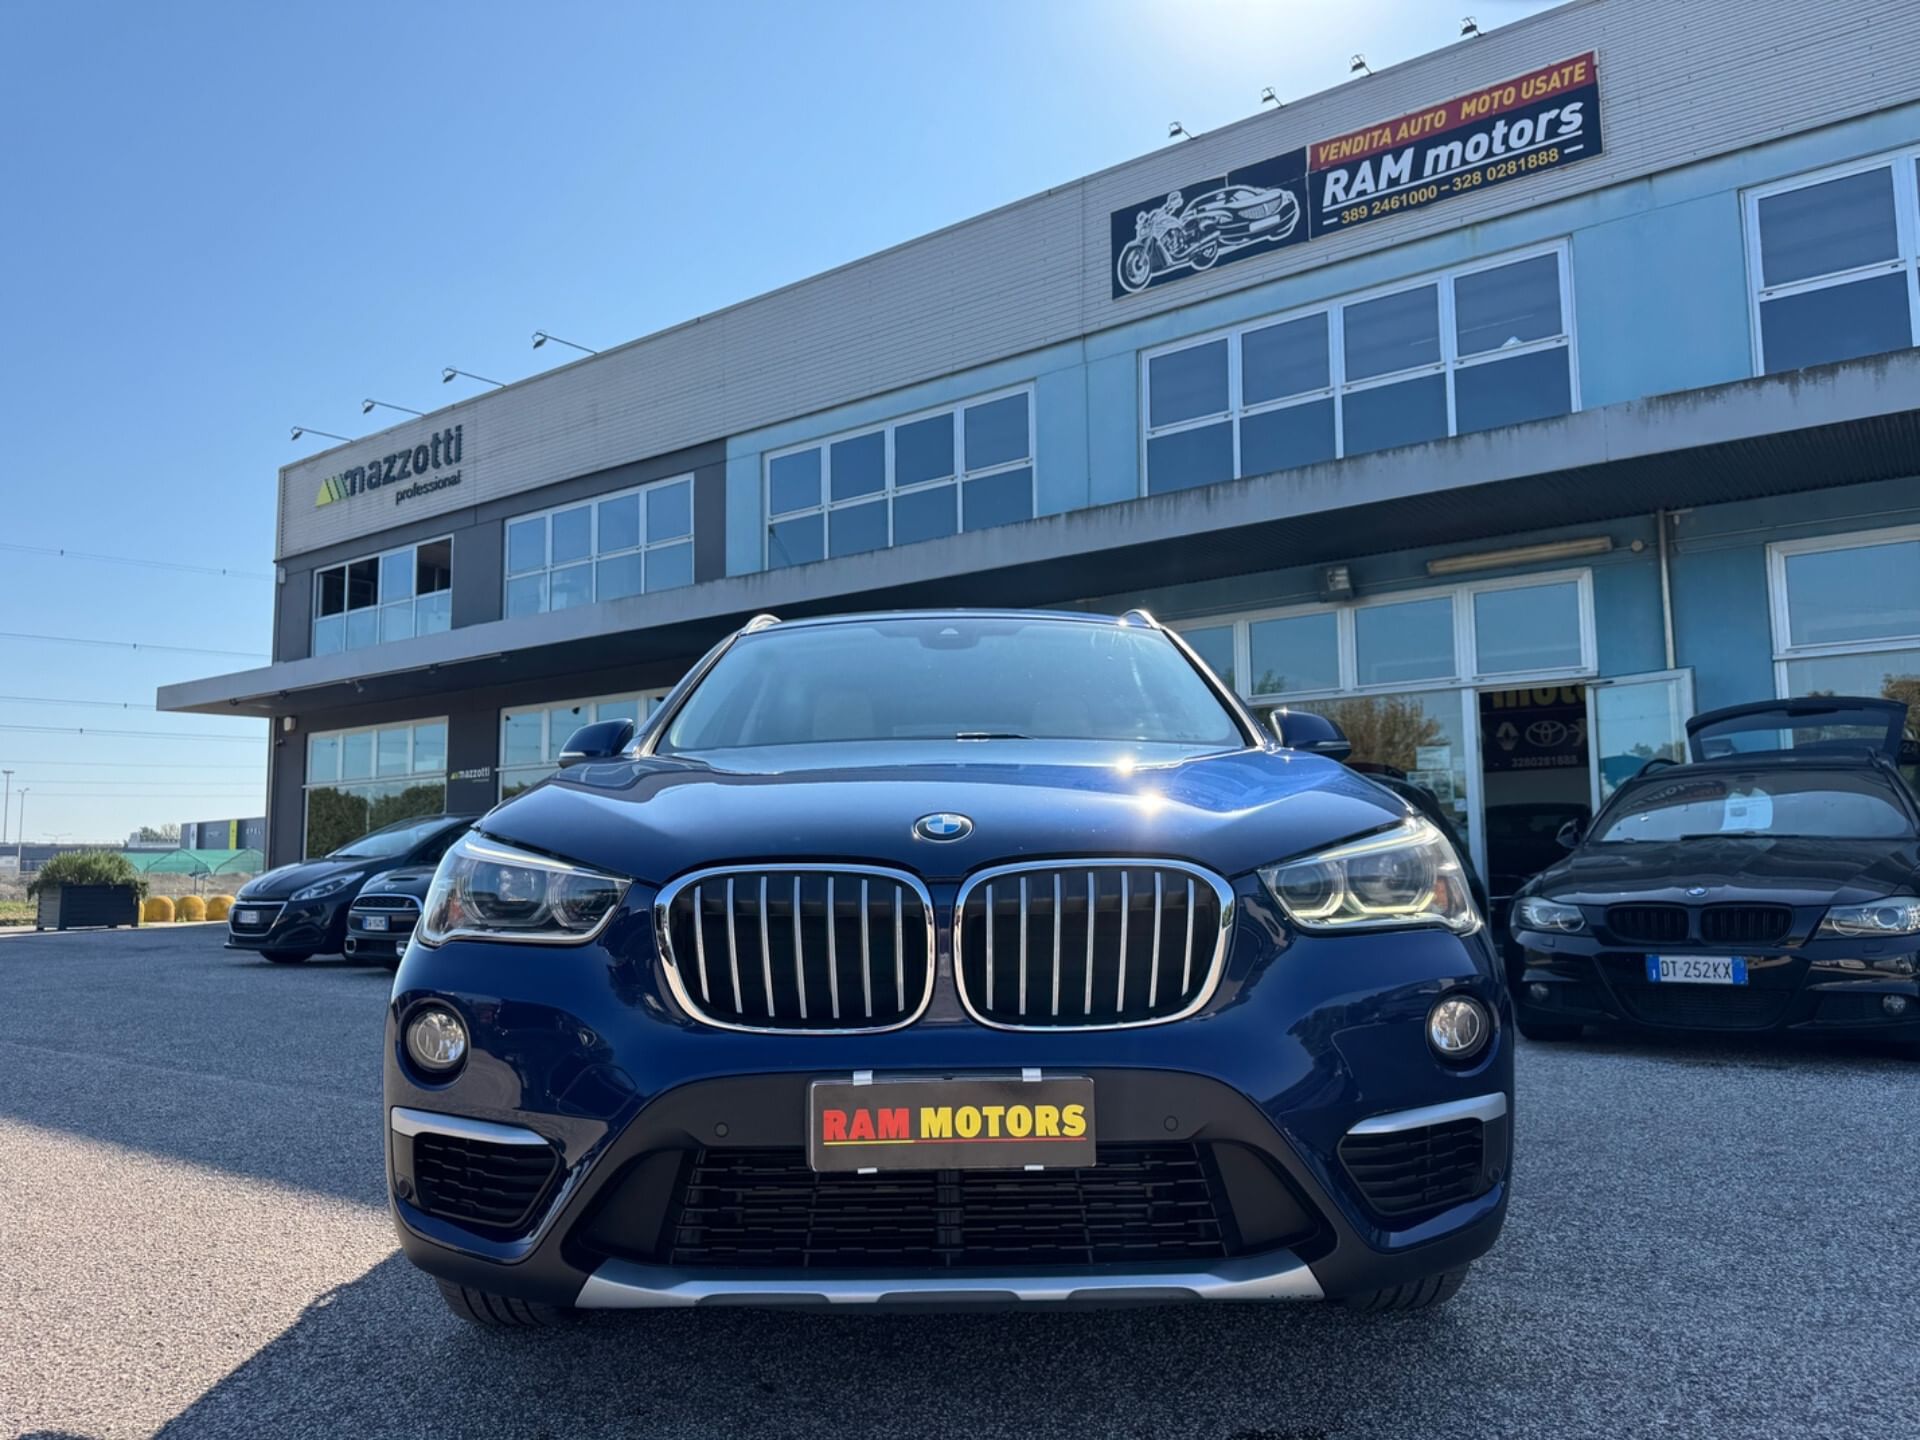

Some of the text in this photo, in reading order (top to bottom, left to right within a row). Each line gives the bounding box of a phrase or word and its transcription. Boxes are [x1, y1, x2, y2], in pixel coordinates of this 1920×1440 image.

[1318, 61, 1586, 163] VENDITA AUTO MOTO USATE
[1322, 101, 1584, 208] RAM motors
[1341, 205, 1368, 225] 389
[1372, 185, 1438, 215] 2461000
[1452, 171, 1482, 192] 328
[1486, 148, 1560, 182] 0281888
[344, 424, 463, 497] mazzotti
[395, 470, 462, 506] professional
[1661, 960, 1677, 977] DT
[1683, 961, 1732, 979] 252KX
[822, 1104, 1087, 1141] RAM MOTORS
